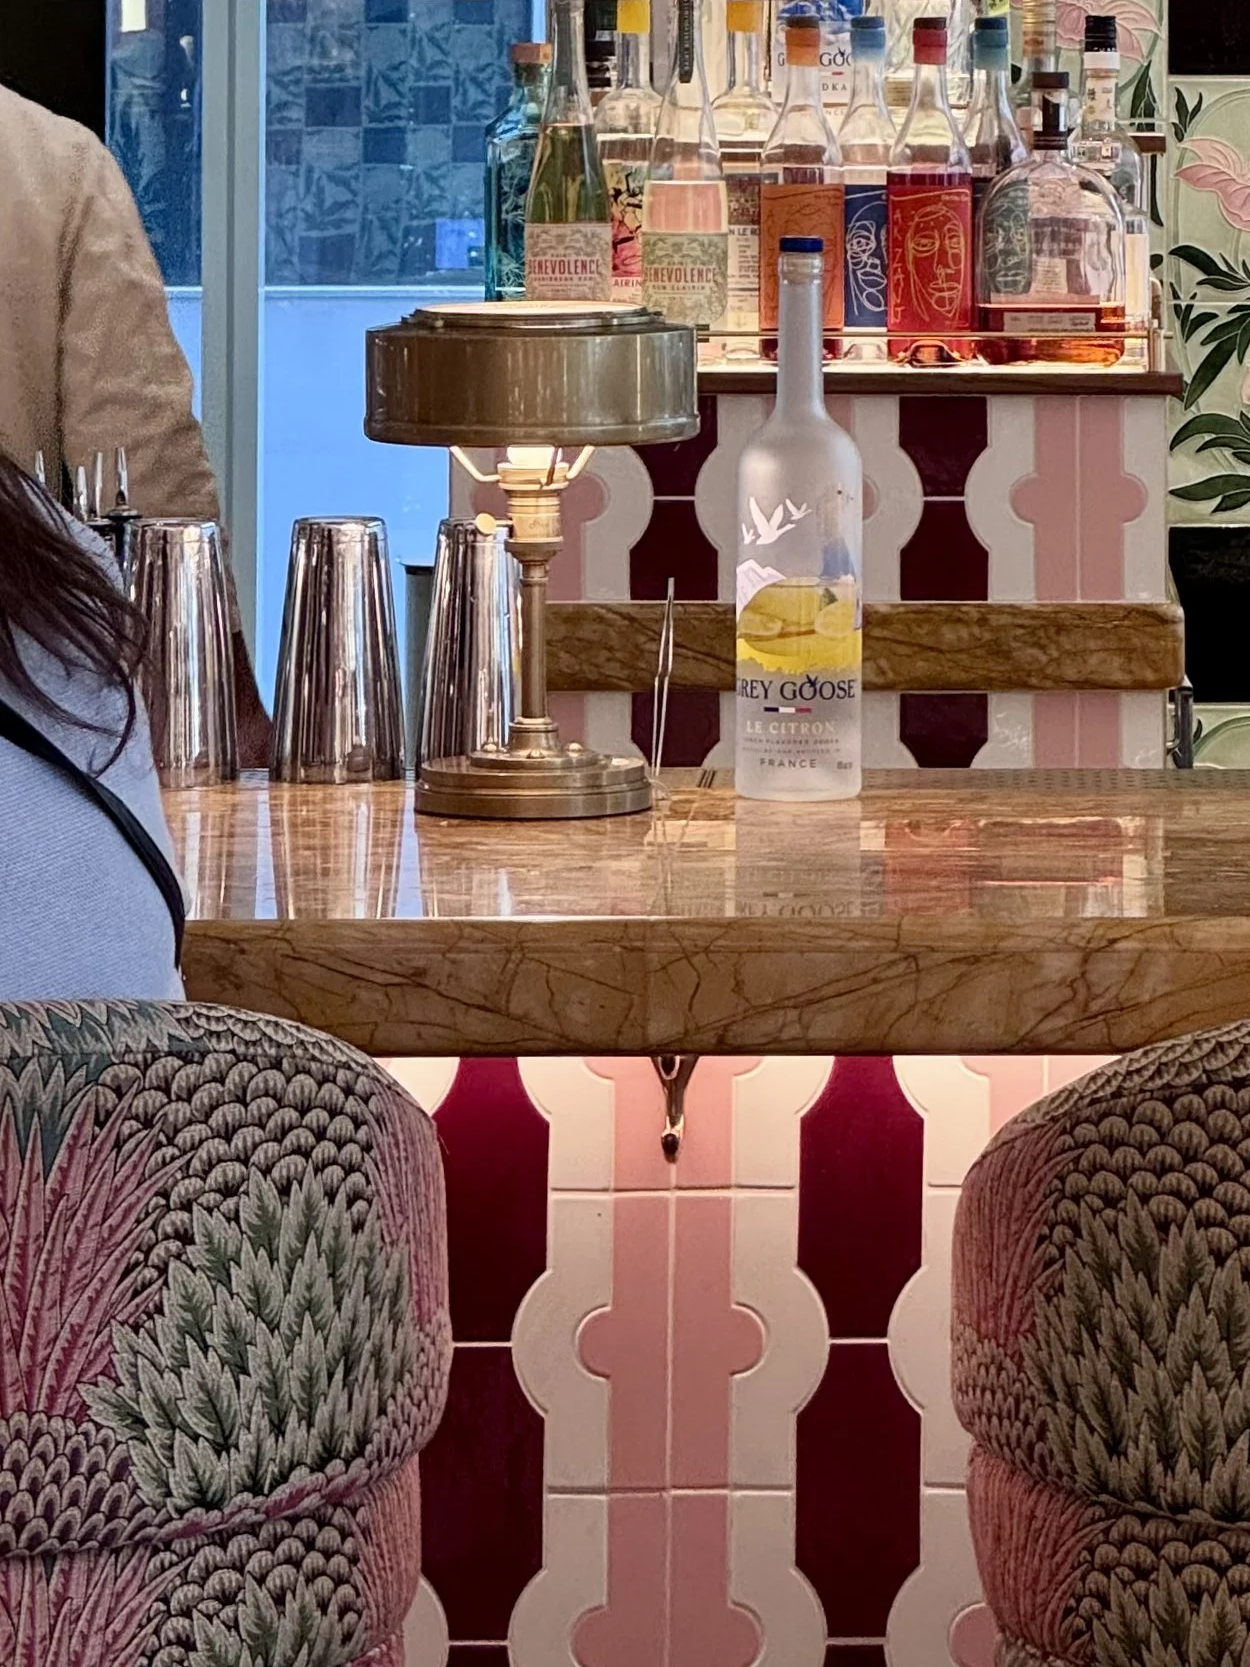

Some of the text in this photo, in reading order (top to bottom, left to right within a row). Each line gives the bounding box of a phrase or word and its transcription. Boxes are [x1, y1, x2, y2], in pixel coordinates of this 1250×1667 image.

[529, 258, 600, 275] BENEVOLENCE
[780, 678, 856, 701] GOOSE
[746, 720, 836, 734] LE CITRON
[760, 758, 817, 768] FRANCE
